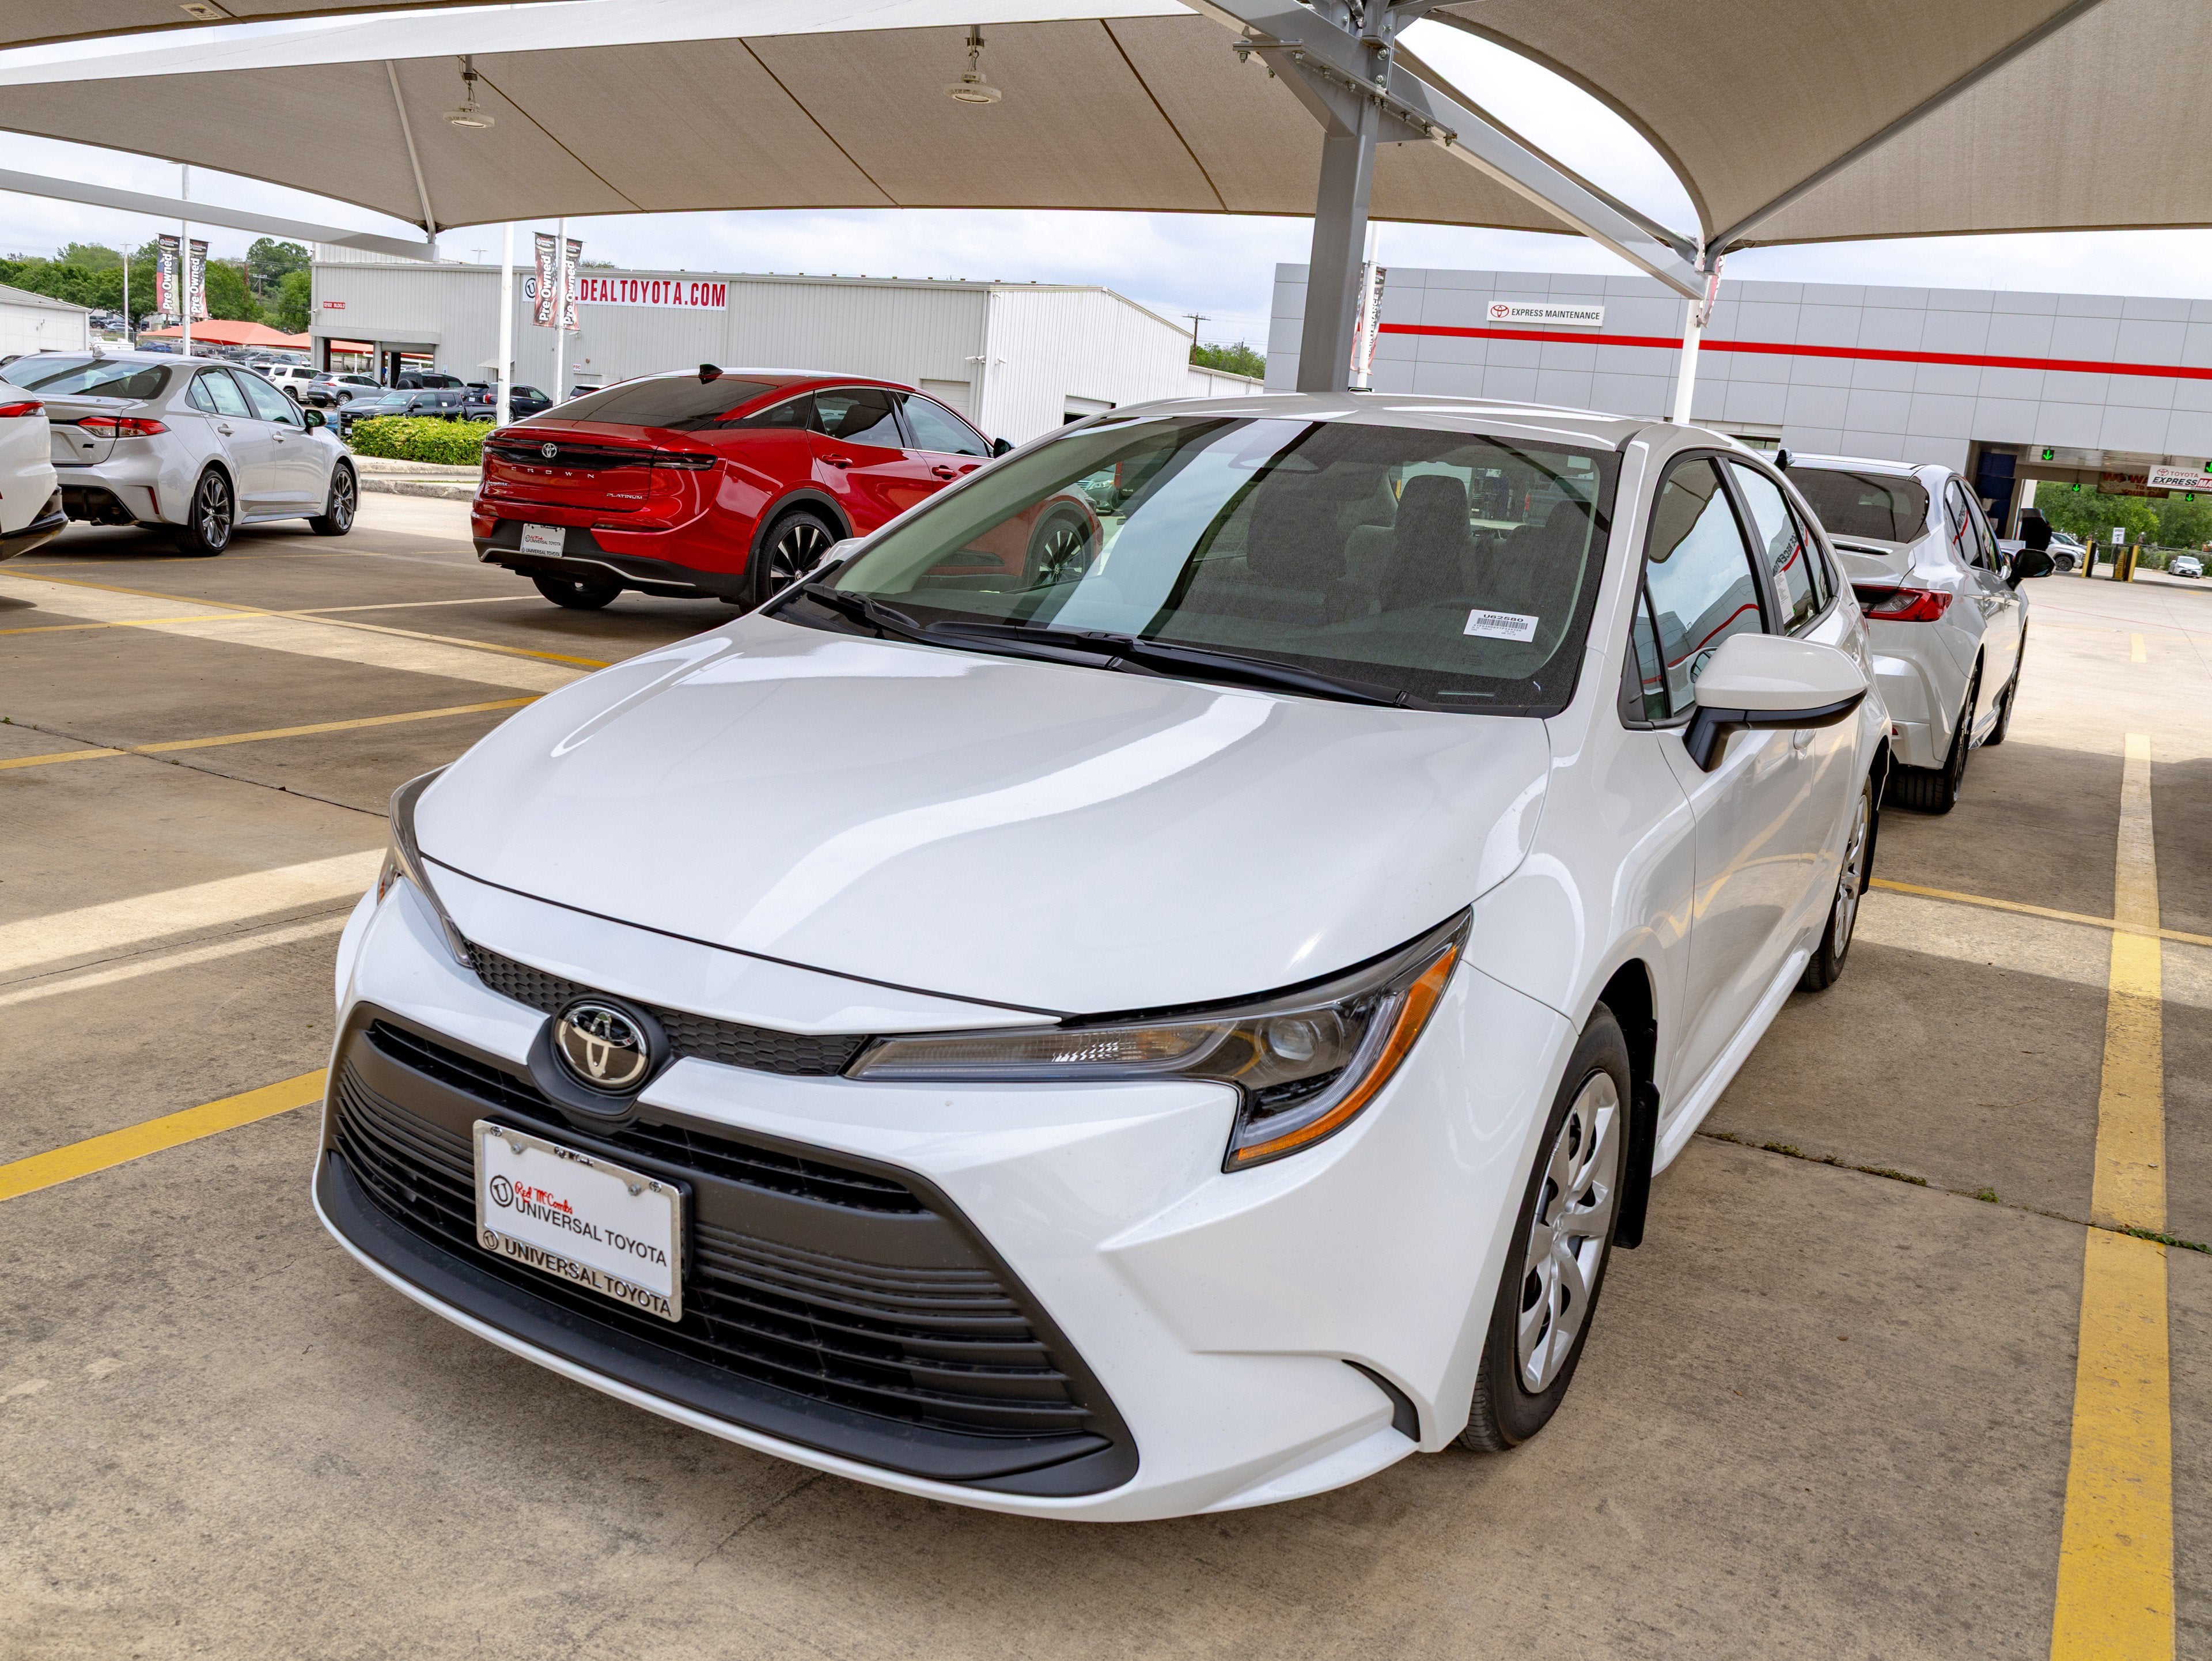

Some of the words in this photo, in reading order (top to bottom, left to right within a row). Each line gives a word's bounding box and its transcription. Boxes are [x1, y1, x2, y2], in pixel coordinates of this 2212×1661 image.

[162, 253, 172, 290] Owned
[190, 258, 200, 294] Owned
[541, 255, 551, 298] Owned
[566, 260, 575, 302] Owned
[162, 292, 173, 310] Pre
[575, 278, 726, 307] DEALTOYOTA.COM
[191, 296, 201, 313] Pre
[539, 300, 551, 321] Pre
[1512, 308, 1543, 317] EXPRESS
[1545, 310, 1600, 320] MAINTENANCE
[564, 305, 574, 325] Pre
[511, 467, 594, 478] CROWN
[2153, 477, 2198, 486] EXPRESS
[1483, 614, 1524, 622] U62580
[514, 1181, 532, 1201] Red
[515, 1197, 603, 1242] UNIVERSAL
[604, 1229, 667, 1267] TOYOTA
[505, 1237, 602, 1288] UNIVERSAL
[604, 1274, 672, 1317] TOYOTA
